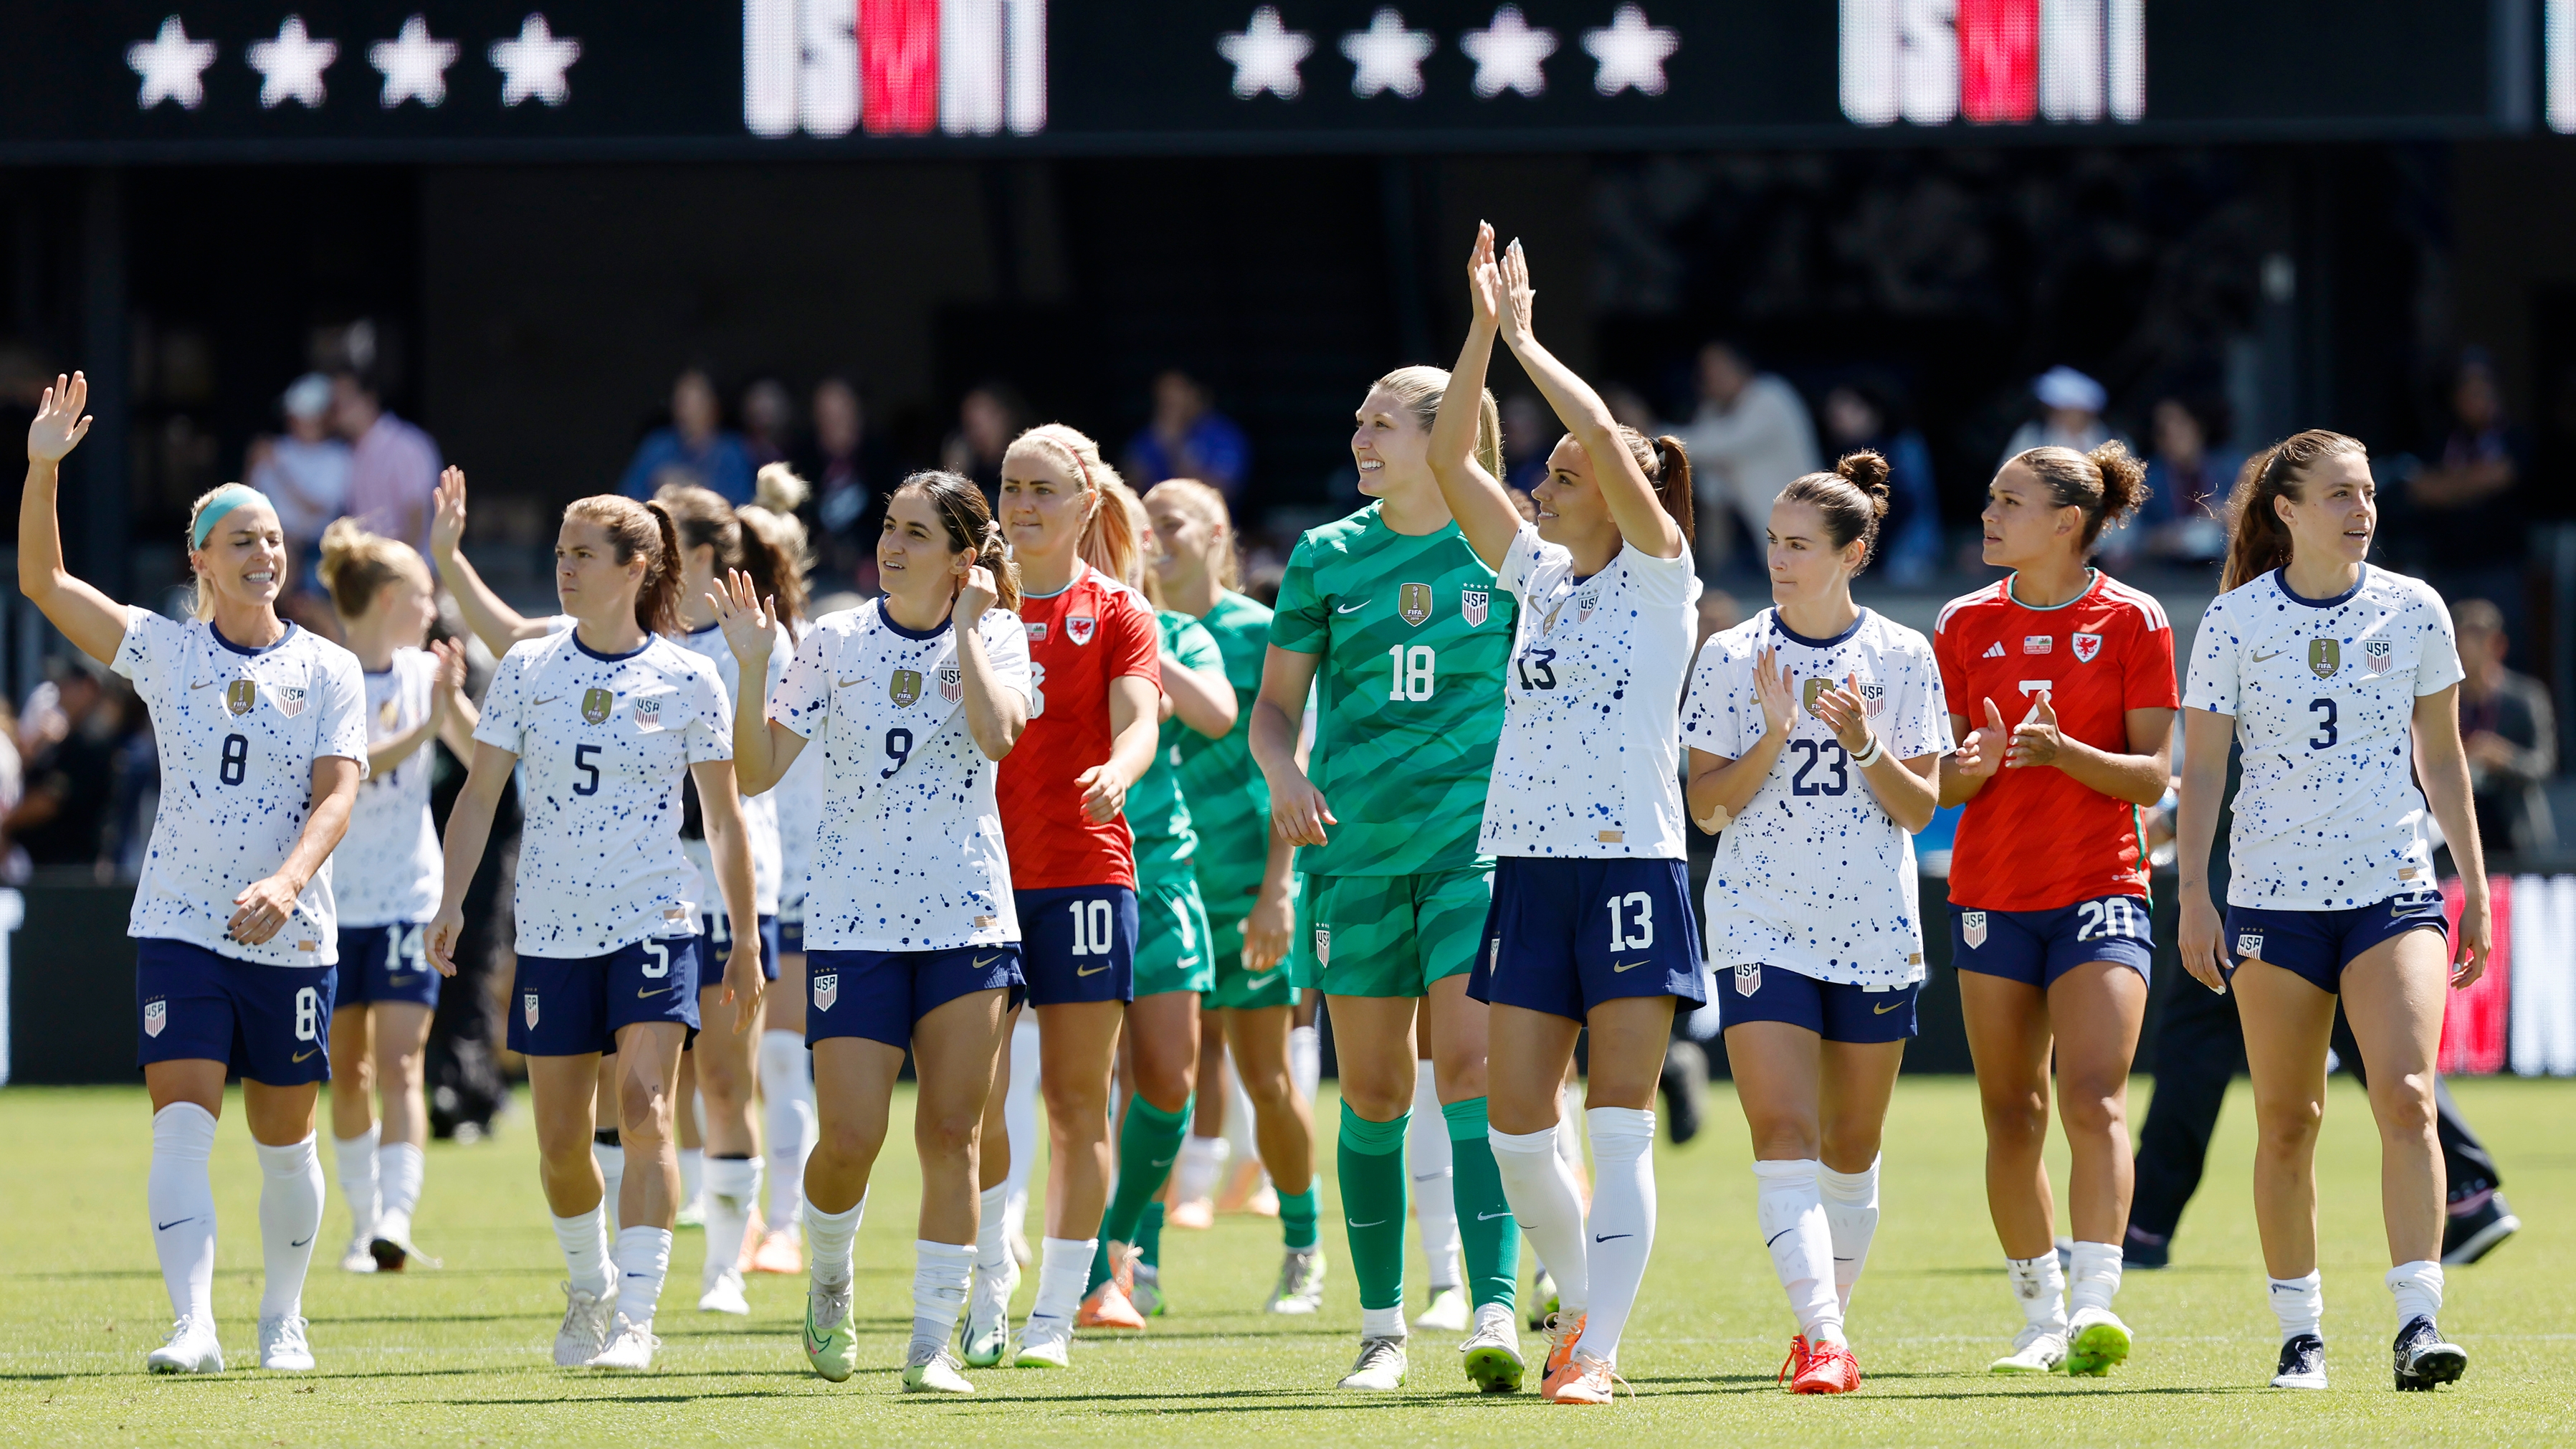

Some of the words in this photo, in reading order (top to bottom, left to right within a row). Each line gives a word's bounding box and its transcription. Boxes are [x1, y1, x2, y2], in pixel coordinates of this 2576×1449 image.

[1464, 592, 1487, 607] USA
[1517, 643, 1557, 690] 13
[2366, 642, 2389, 657] USA
[282, 688, 304, 701] USA
[1388, 644, 1436, 702] 18
[1860, 685, 1883, 700] USA
[637, 698, 659, 713] USA
[2309, 698, 2337, 750] 3
[220, 733, 249, 787] 8
[573, 743, 602, 797] 5
[880, 728, 913, 779] 9
[1791, 739, 1848, 796] 23
[1069, 899, 1112, 956] 10
[1606, 891, 1654, 952] 13
[1964, 914, 1984, 928] USA
[2077, 897, 2135, 942] 20
[384, 923, 429, 972] 14
[641, 938, 669, 979] 5
[2240, 936, 2261, 951] USA
[815, 976, 835, 991] USA
[1736, 963, 1758, 977] USA
[146, 1003, 164, 1018] USA
[295, 986, 317, 1042] 8
[525, 997, 537, 1010] SA
